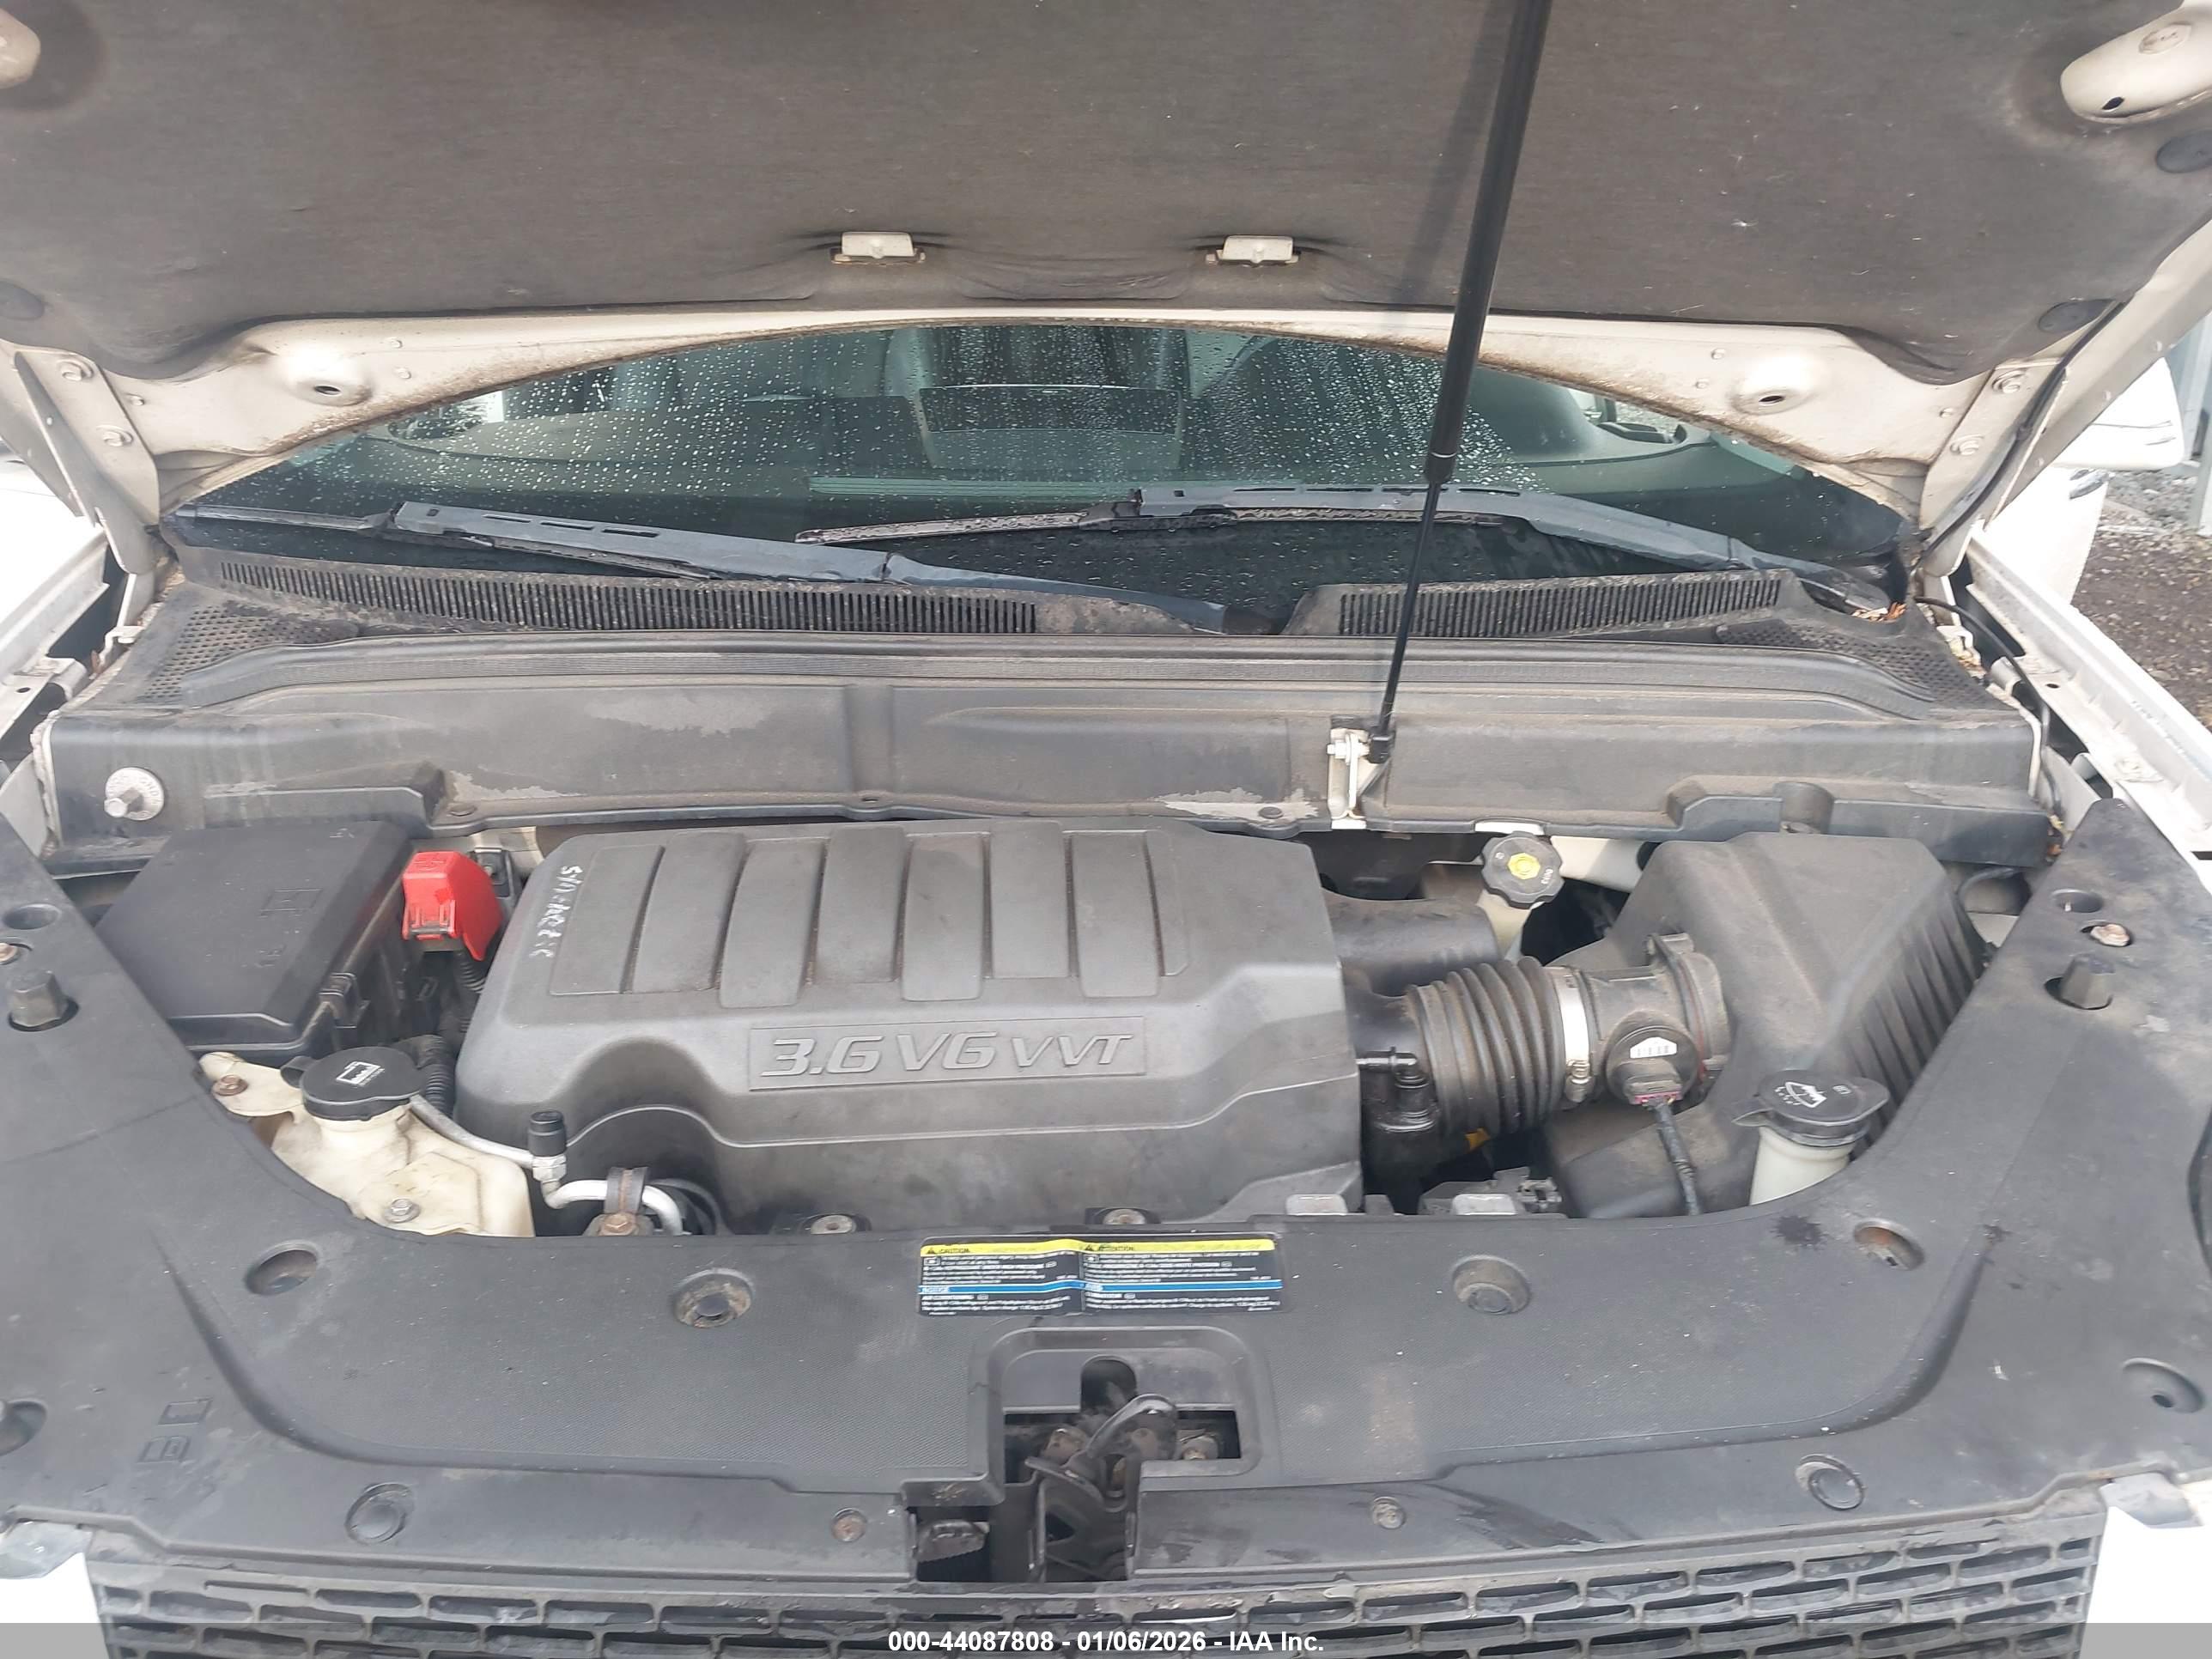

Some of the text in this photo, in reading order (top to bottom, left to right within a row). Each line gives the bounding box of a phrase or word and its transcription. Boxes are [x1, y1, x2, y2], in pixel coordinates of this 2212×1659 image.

[760, 1030, 1133, 1076] 3.6 V6 VVT
